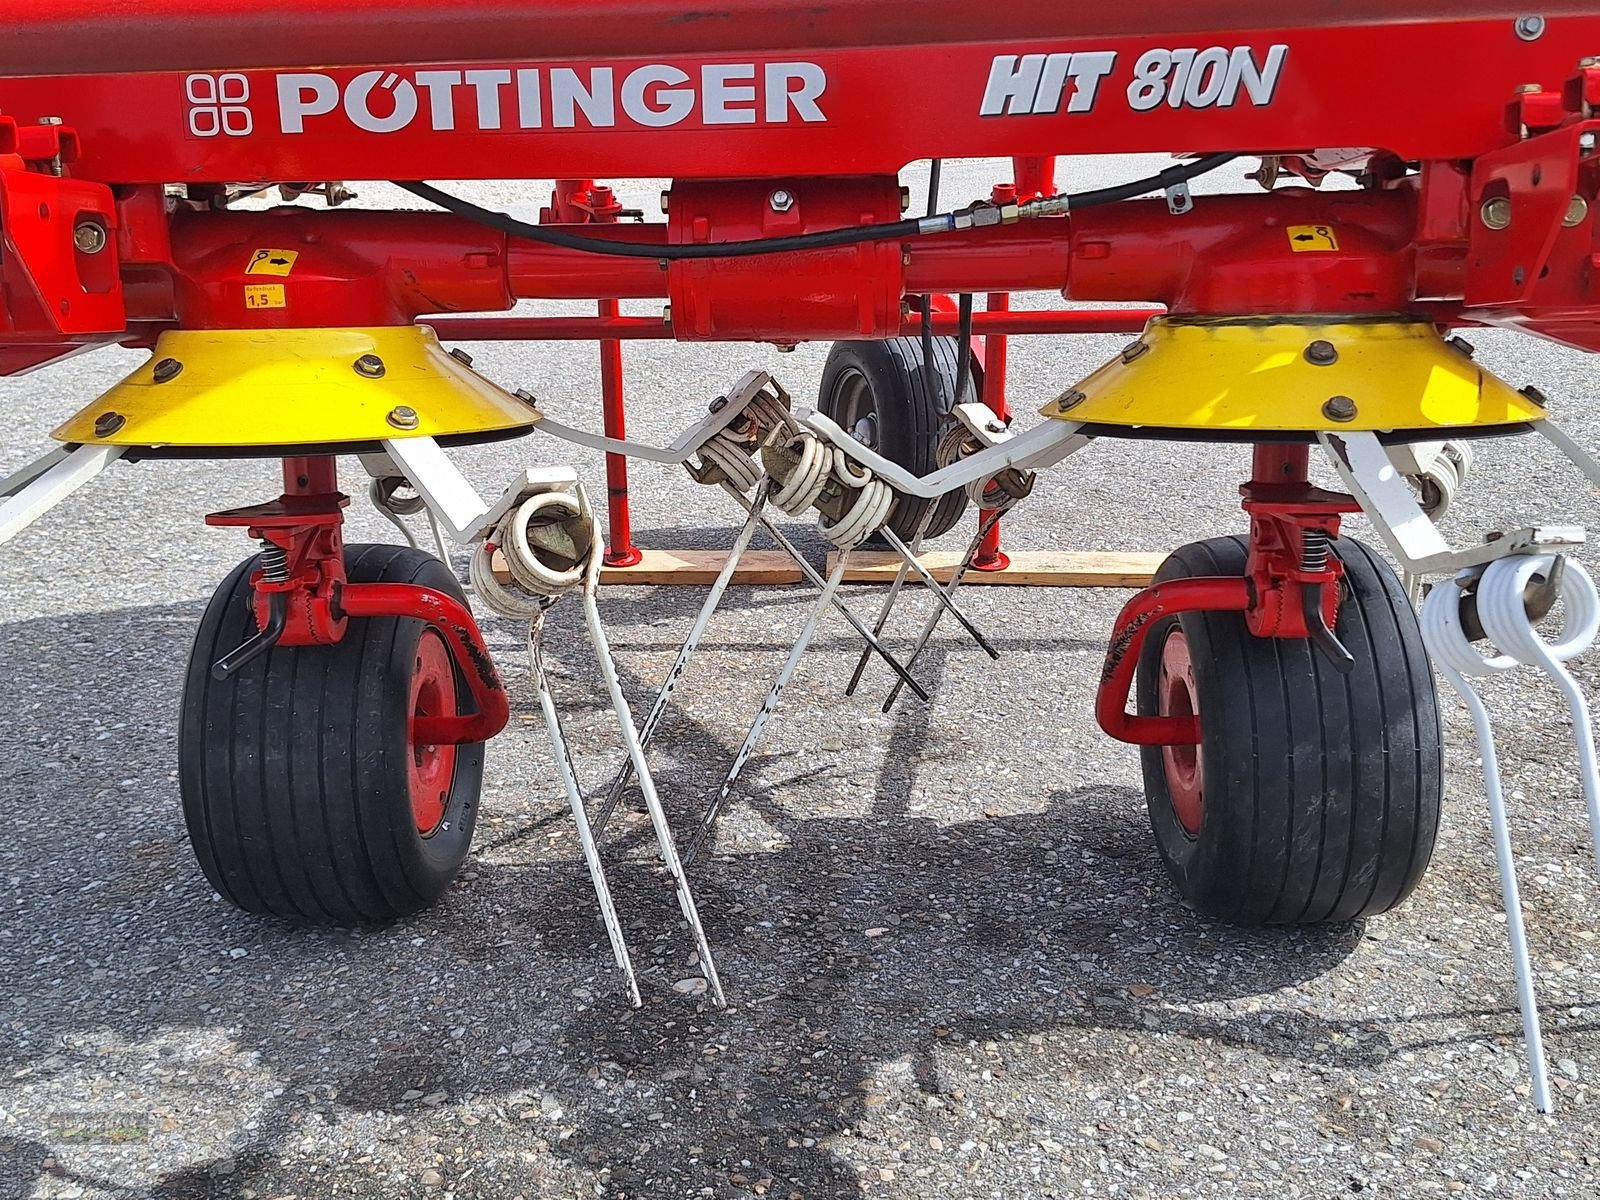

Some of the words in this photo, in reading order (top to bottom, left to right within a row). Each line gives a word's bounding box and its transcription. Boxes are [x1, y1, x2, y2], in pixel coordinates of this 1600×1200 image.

[276, 62, 827, 134] PÖTTINGER
[980, 51, 1118, 116] HIT
[1126, 44, 1289, 111] 810N
[248, 294, 269, 307] 1,5
